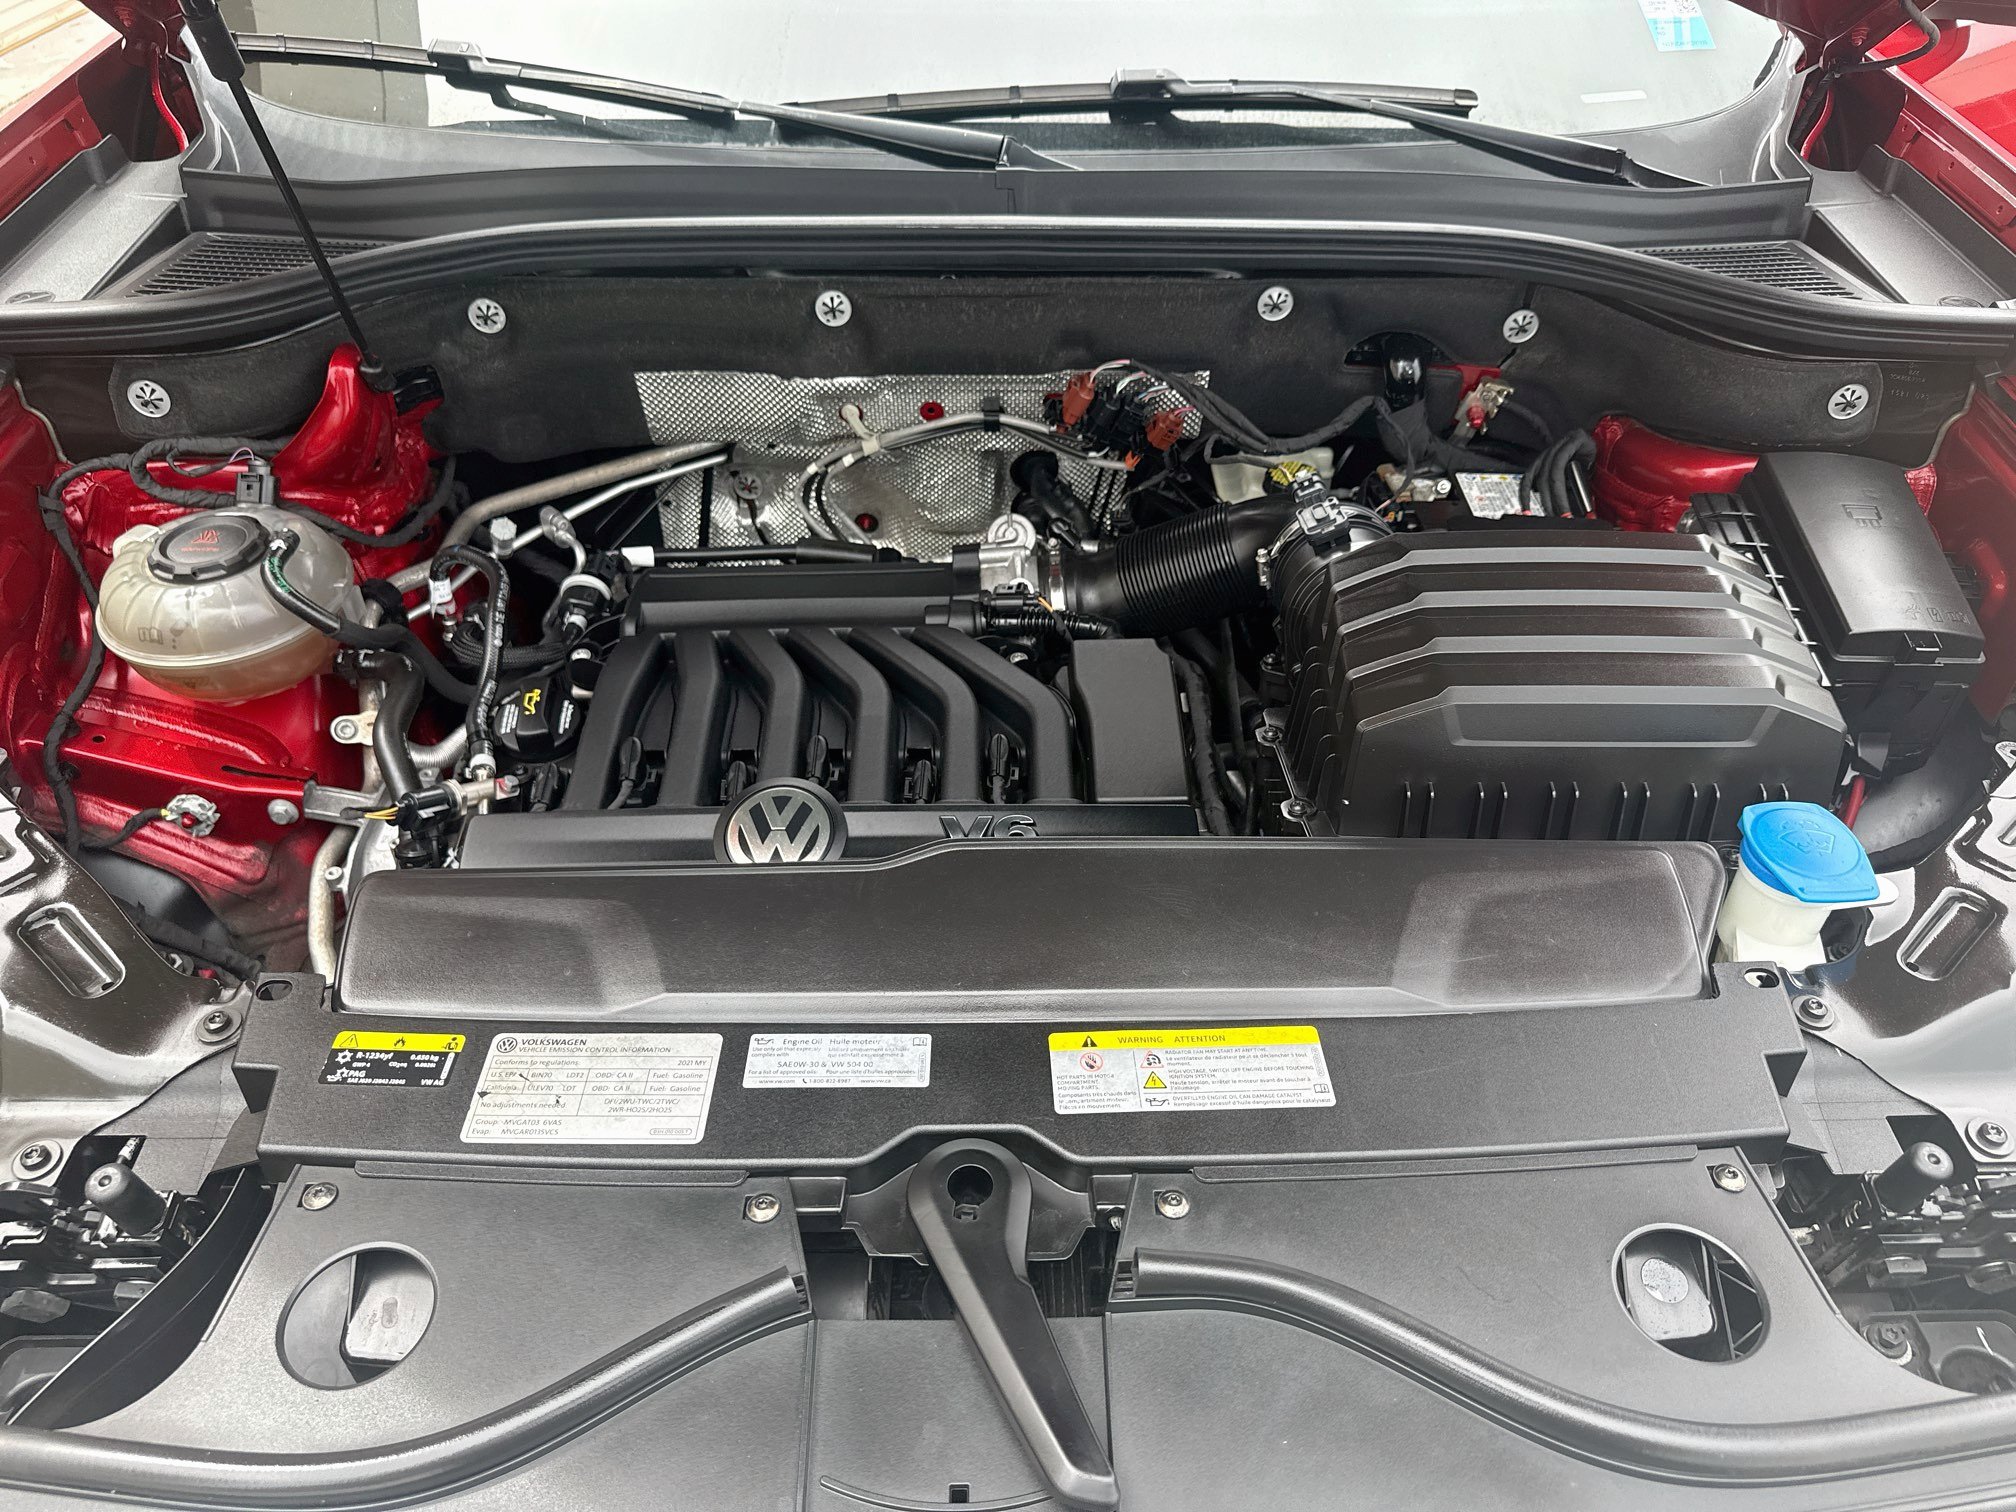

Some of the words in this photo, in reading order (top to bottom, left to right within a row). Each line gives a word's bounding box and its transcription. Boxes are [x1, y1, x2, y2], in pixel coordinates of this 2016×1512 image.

[939, 814, 1038, 838] V6
[521, 1038, 587, 1046] VOLKSWAGEN
[783, 1038, 810, 1046] Engine
[1117, 1036, 1164, 1044] WARNING
[1174, 1035, 1226, 1043] ATTENTION
[356, 1051, 394, 1061] R-1234yf
[430, 1054, 440, 1063] kg
[347, 1070, 367, 1078] PAG
[530, 1071, 553, 1079] BIN70
[420, 1078, 434, 1086] VW
[492, 1101, 537, 1110] adjustments
